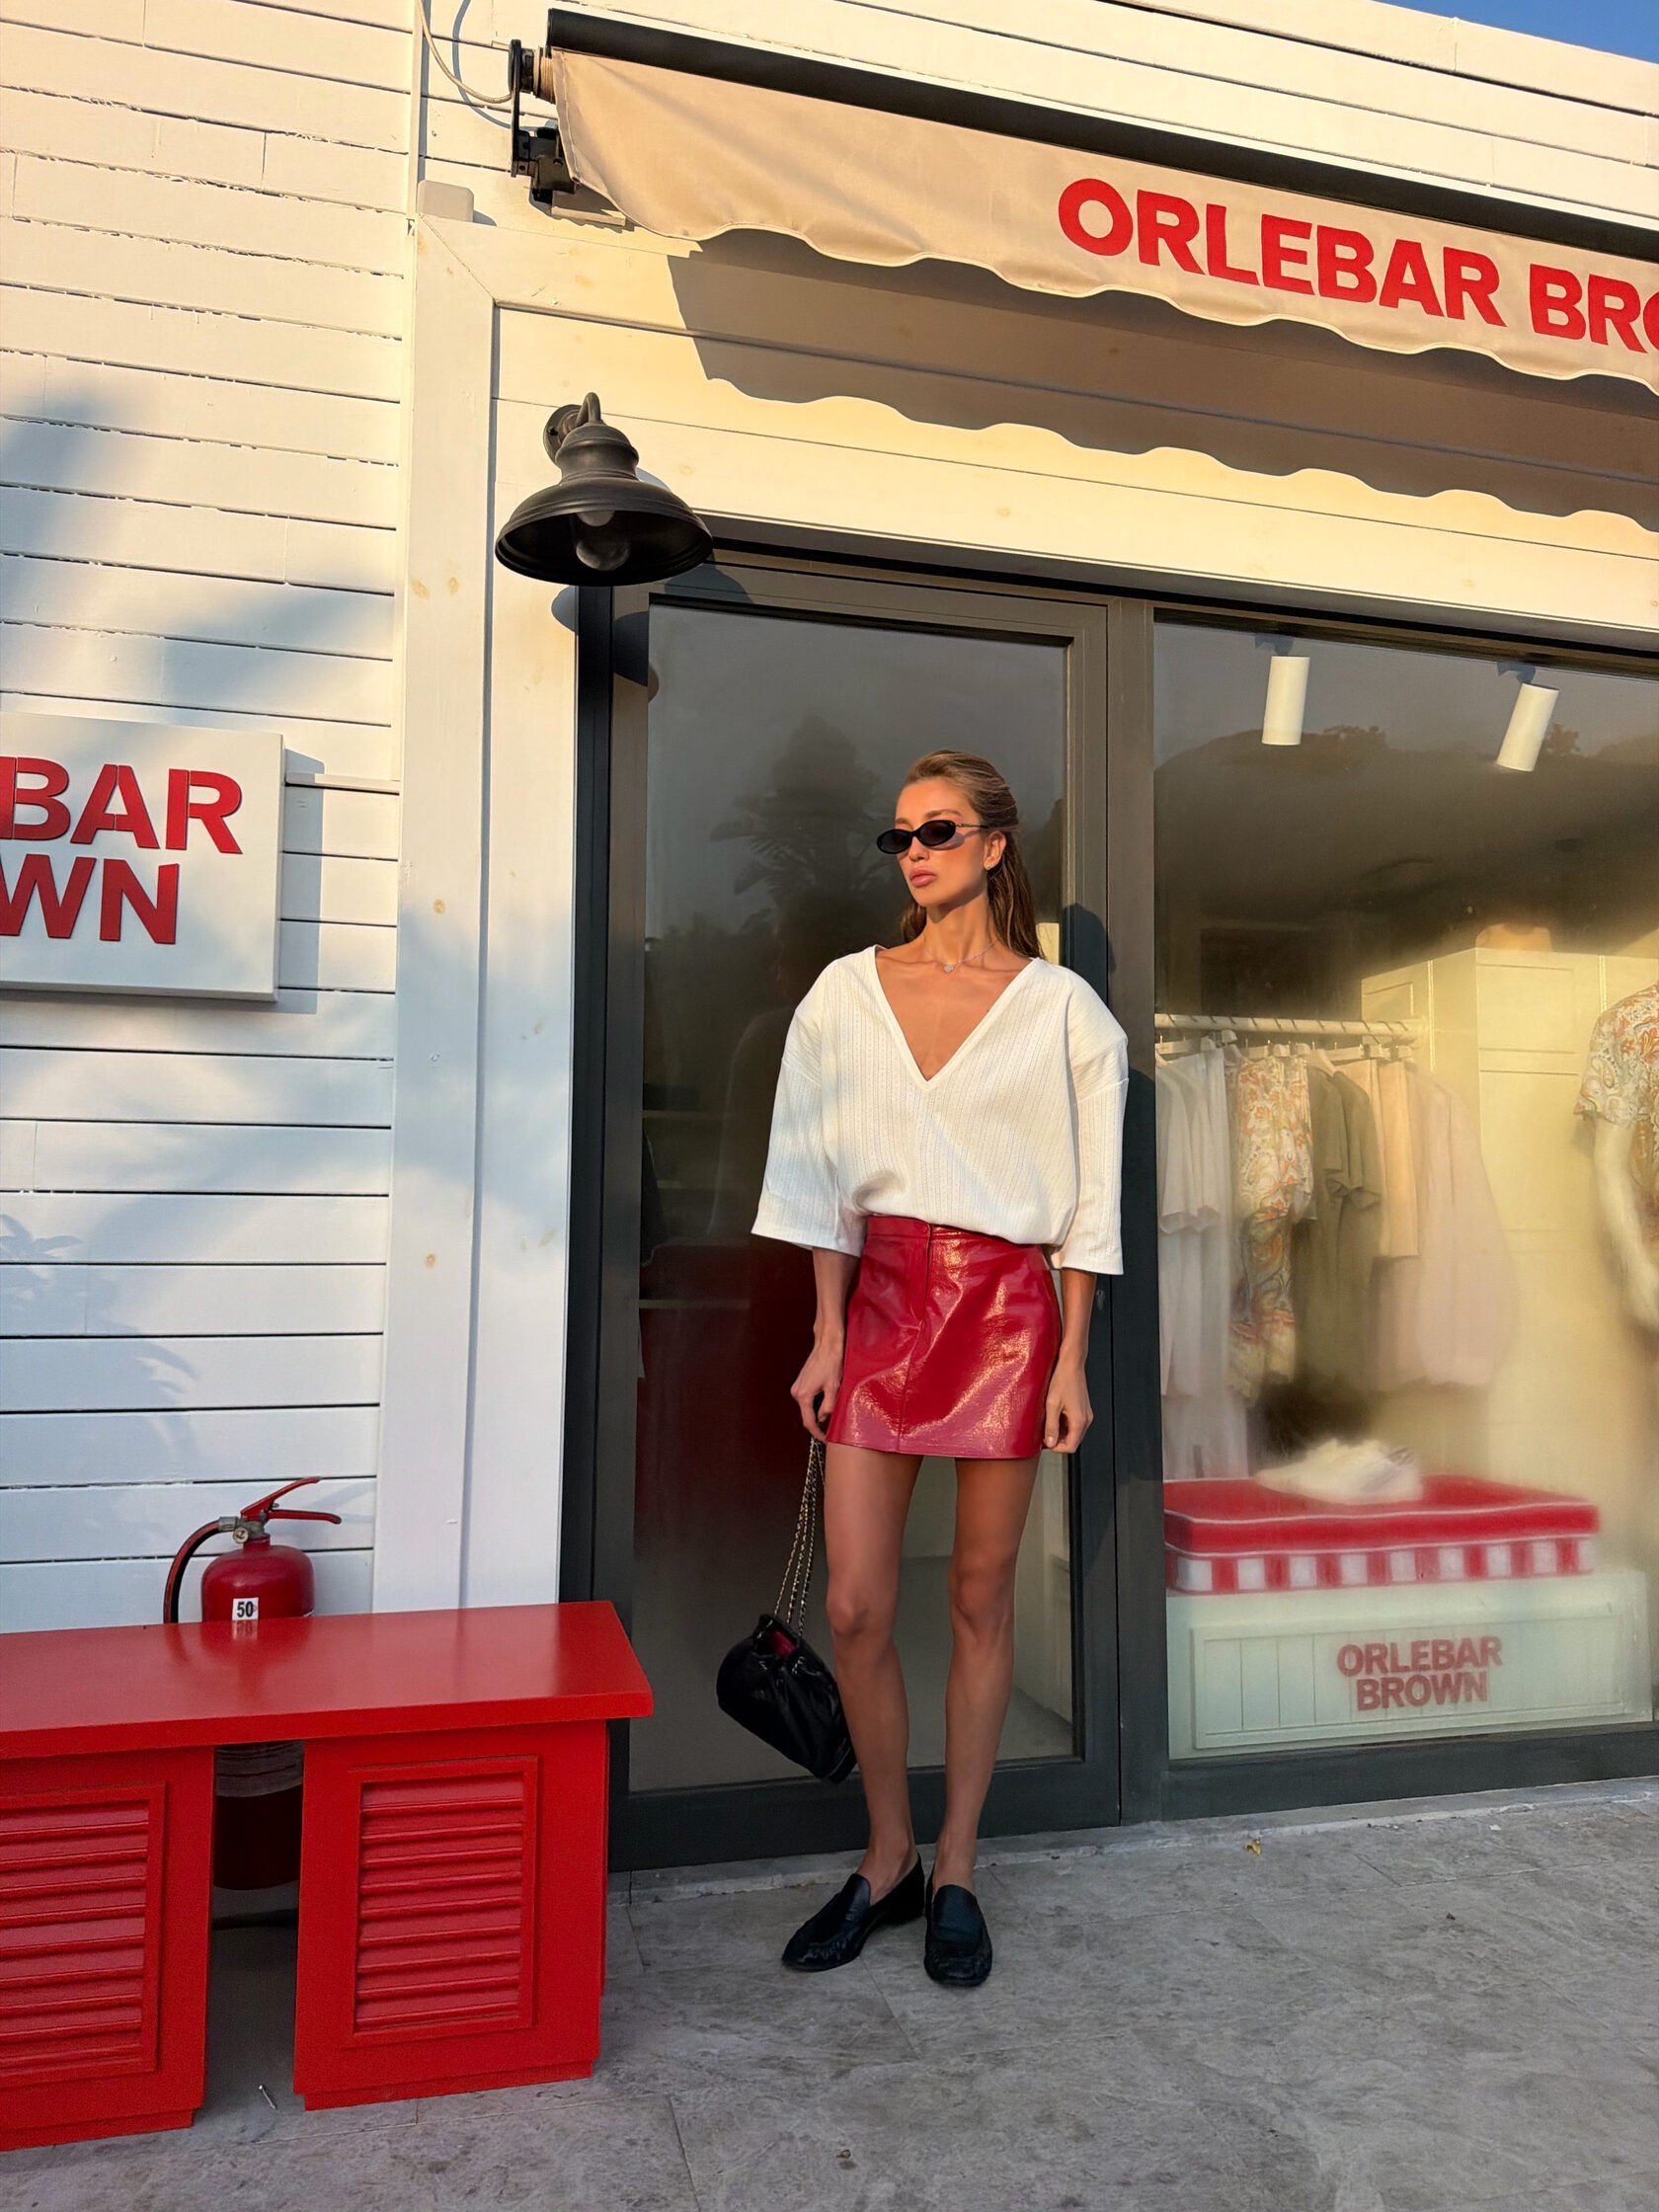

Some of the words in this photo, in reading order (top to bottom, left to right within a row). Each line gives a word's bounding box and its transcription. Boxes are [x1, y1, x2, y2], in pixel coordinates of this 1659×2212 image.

[1058, 178, 1507, 328] ORLEBAR
[1529, 263, 1659, 354] BR
[0, 755, 243, 855] BAR
[0, 853, 180, 945] WN
[237, 1601, 254, 1618] 50
[1337, 1635, 1503, 1677] ORLEBAR
[1356, 1671, 1488, 1711] BROWN
